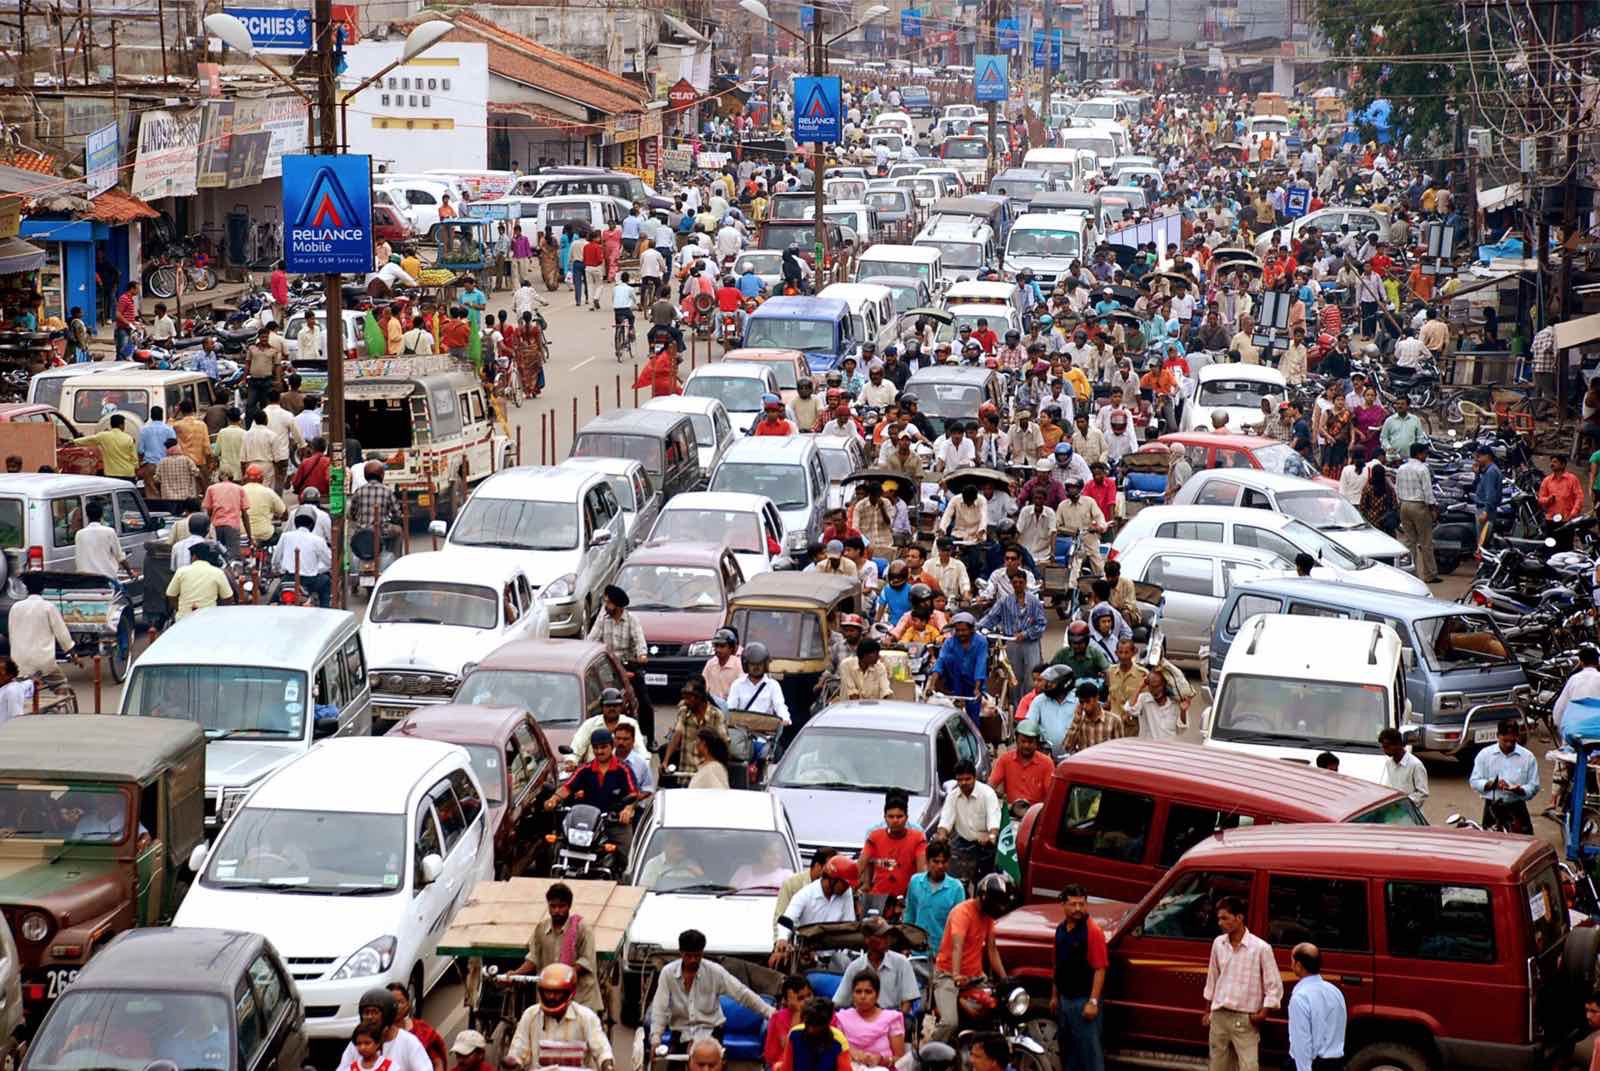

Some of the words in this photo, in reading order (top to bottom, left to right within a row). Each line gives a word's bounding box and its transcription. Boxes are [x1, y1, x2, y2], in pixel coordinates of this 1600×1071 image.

[233, 16, 295, 36] RCHIES
[361, 76, 451, 91] APITOL
[381, 94, 431, 107] HILL
[292, 241, 333, 253] Mobile
[293, 257, 316, 265] Smart
[318, 256, 335, 265] GSM
[337, 256, 364, 265] Service
